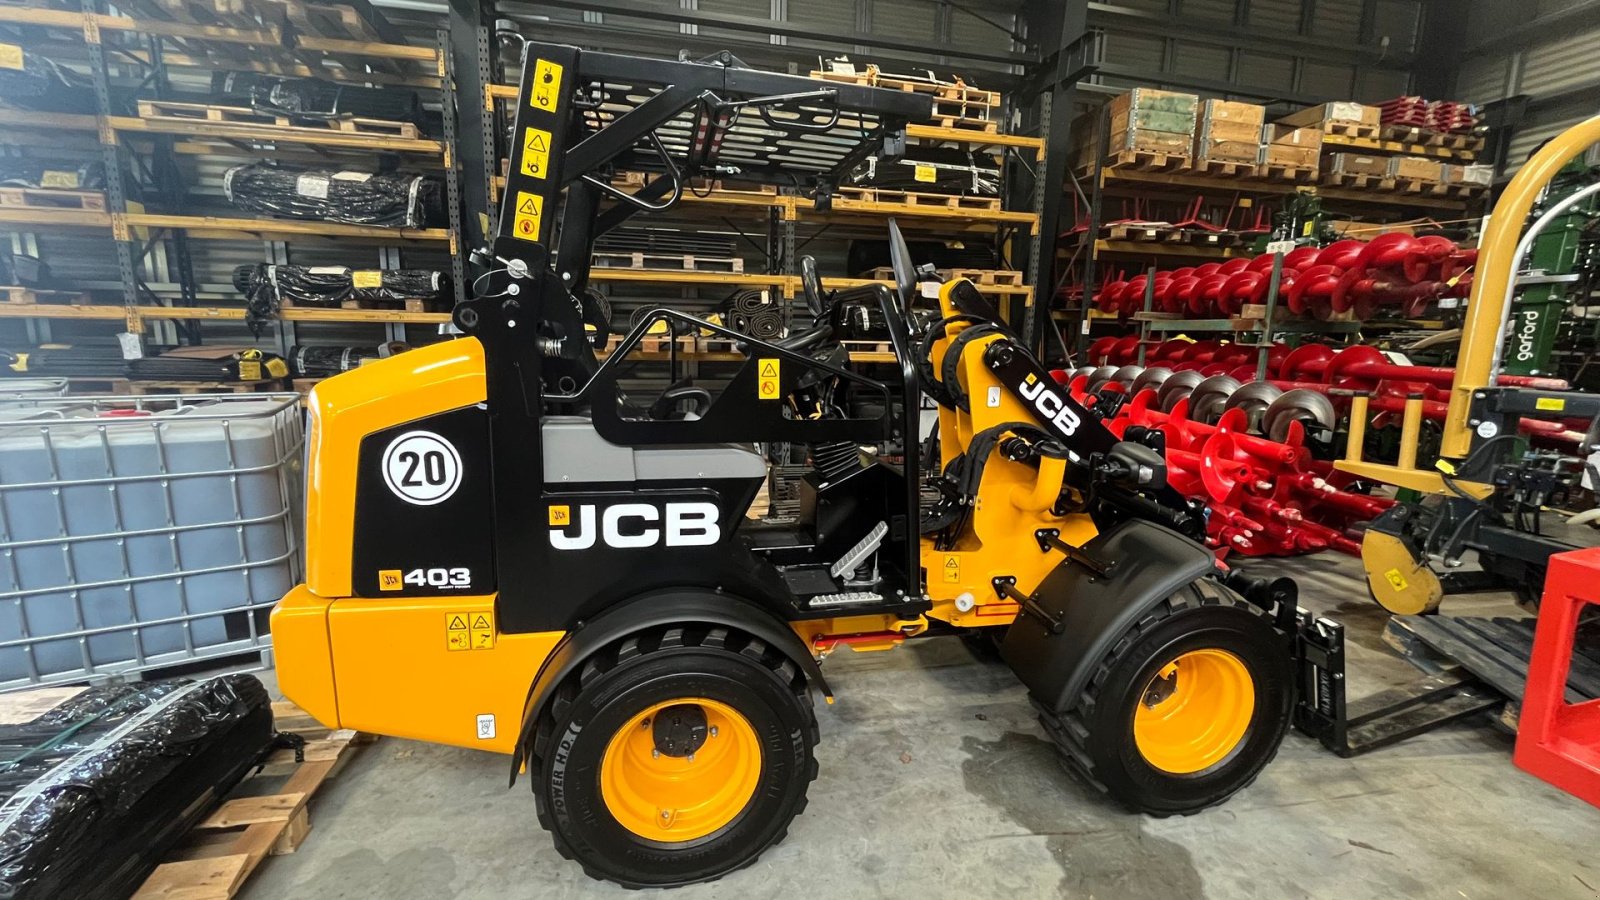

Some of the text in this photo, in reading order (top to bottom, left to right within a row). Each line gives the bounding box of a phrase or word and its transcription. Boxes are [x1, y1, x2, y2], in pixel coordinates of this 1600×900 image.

[1517, 311, 1539, 361] garford
[1019, 373, 1081, 437] JCB
[398, 450, 447, 487] 20
[548, 502, 721, 550] JCB
[404, 567, 471, 587] 403
[552, 770, 567, 816] POWER
